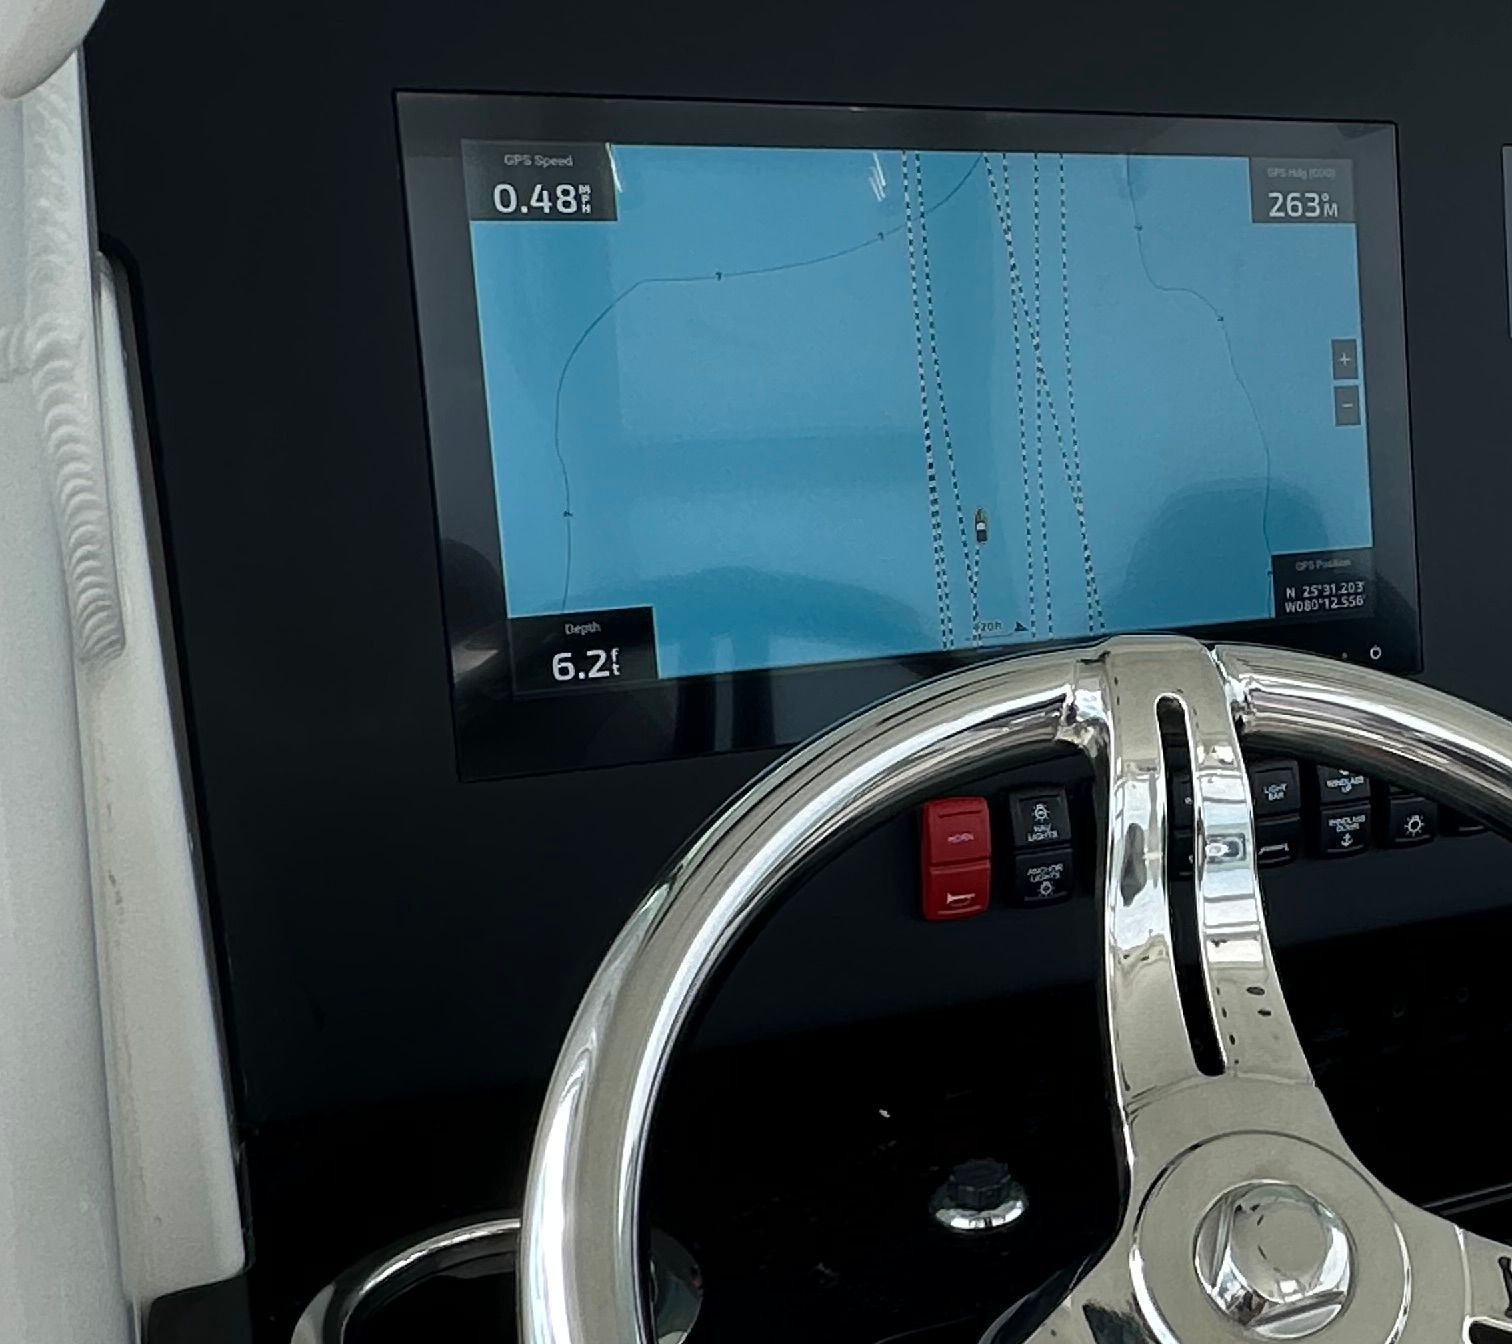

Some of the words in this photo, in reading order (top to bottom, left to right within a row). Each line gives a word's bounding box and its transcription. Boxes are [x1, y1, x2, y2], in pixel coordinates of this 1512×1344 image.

[503, 154, 532, 166] GPS
[534, 155, 574, 169] Speed
[493, 183, 578, 214] 0.48
[1295, 561, 1315, 572] GPS
[1286, 586, 1296, 600] N
[564, 621, 601, 636] Depth
[552, 649, 610, 681] 6.2
[1263, 783, 1288, 794] LIGHT
[1268, 791, 1285, 801] BAR
[1027, 830, 1059, 842] LIGHTS
[1030, 871, 1061, 883] LIGHTS
